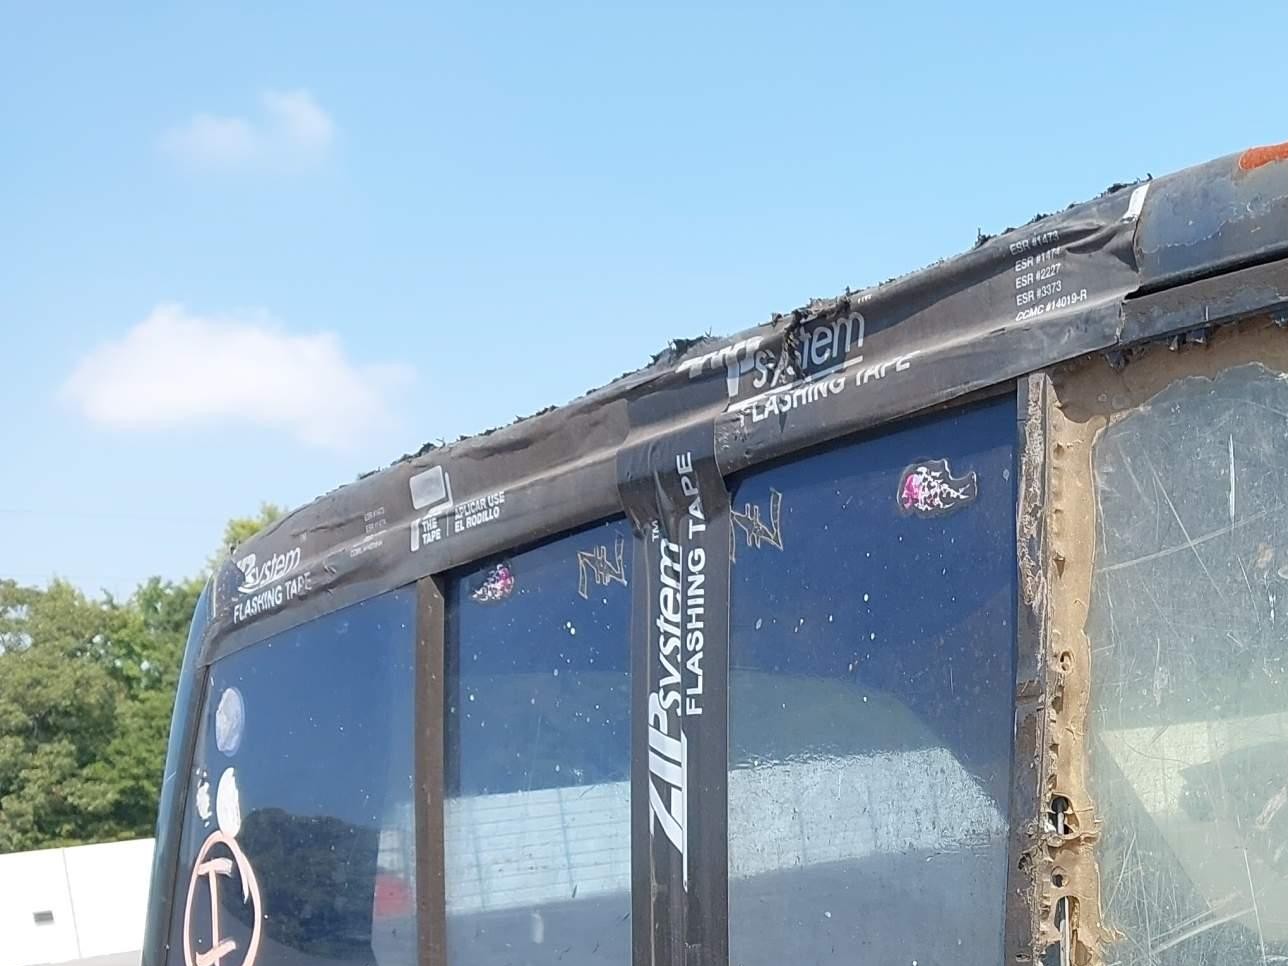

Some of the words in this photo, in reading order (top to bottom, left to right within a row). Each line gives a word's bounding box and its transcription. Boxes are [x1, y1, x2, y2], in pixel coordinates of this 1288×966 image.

[1009, 240, 1029, 255] ESR
[1015, 256, 1034, 271] ESR
[1015, 272, 1034, 289] ESR
[1035, 262, 1062, 281] #2227
[1016, 289, 1035, 306] ESR
[1036, 280, 1062, 298] #3373
[676, 451, 706, 540] TAPE
[421, 516, 438, 533] THE
[454, 520, 465, 533] EL
[466, 505, 500, 529] RODILLO
[422, 528, 441, 545] TAPE
[233, 585, 283, 625] FLASHING
[285, 571, 312, 600] TAPE
[686, 547, 706, 716] FLASHING
